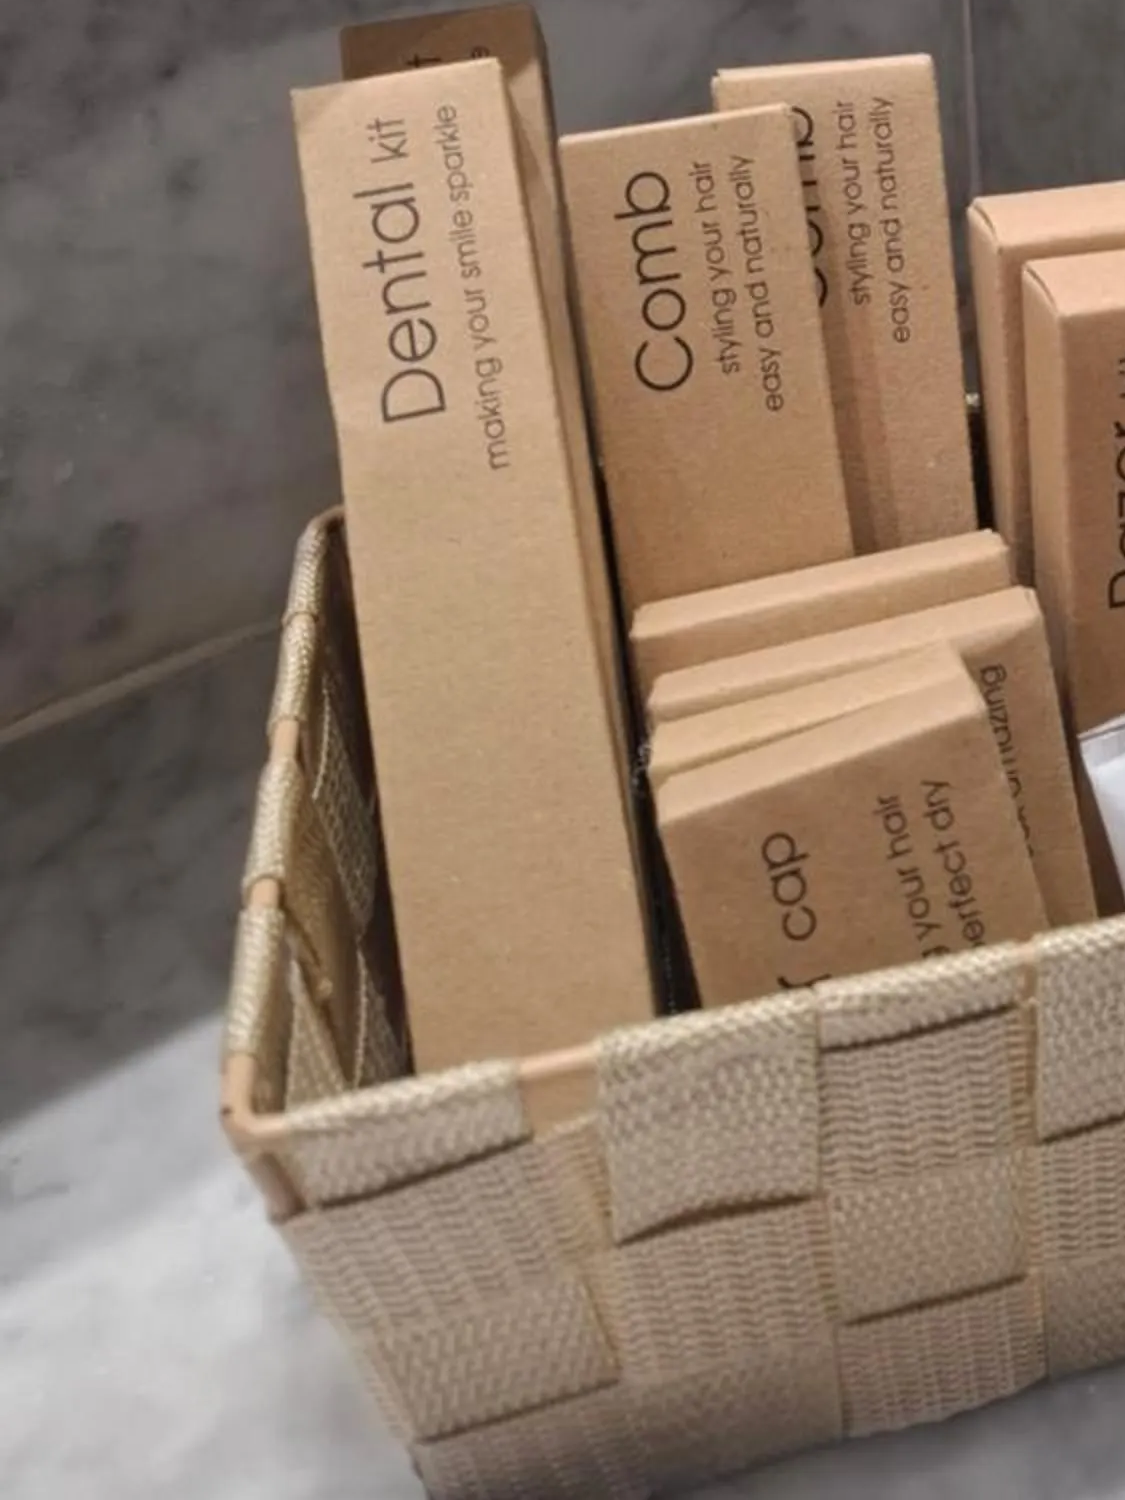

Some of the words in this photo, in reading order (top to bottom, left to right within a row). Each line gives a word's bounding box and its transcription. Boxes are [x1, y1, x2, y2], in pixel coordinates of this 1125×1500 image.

[367, 116, 405, 164] kit
[433, 103, 472, 203] sparkle
[836, 100, 859, 149] hair
[870, 96, 899, 211] naturally
[690, 160, 715, 216] hair
[730, 154, 765, 276] naturally
[841, 157, 867, 217] your
[452, 207, 481, 279] smile
[702, 221, 730, 281] your
[846, 222, 871, 305] styling
[880, 215, 906, 274] and
[354, 181, 445, 423] Dental
[614, 170, 694, 392] Comb
[744, 281, 777, 337] and
[886, 280, 911, 343] easy
[465, 287, 498, 351] your
[710, 284, 741, 375] styling
[754, 344, 784, 411] easy
[472, 358, 509, 470] making
[873, 793, 913, 861] hair
[921, 778, 956, 831] dry
[761, 830, 816, 942] cap
[895, 864, 942, 941] your
[934, 840, 987, 947] erfect
